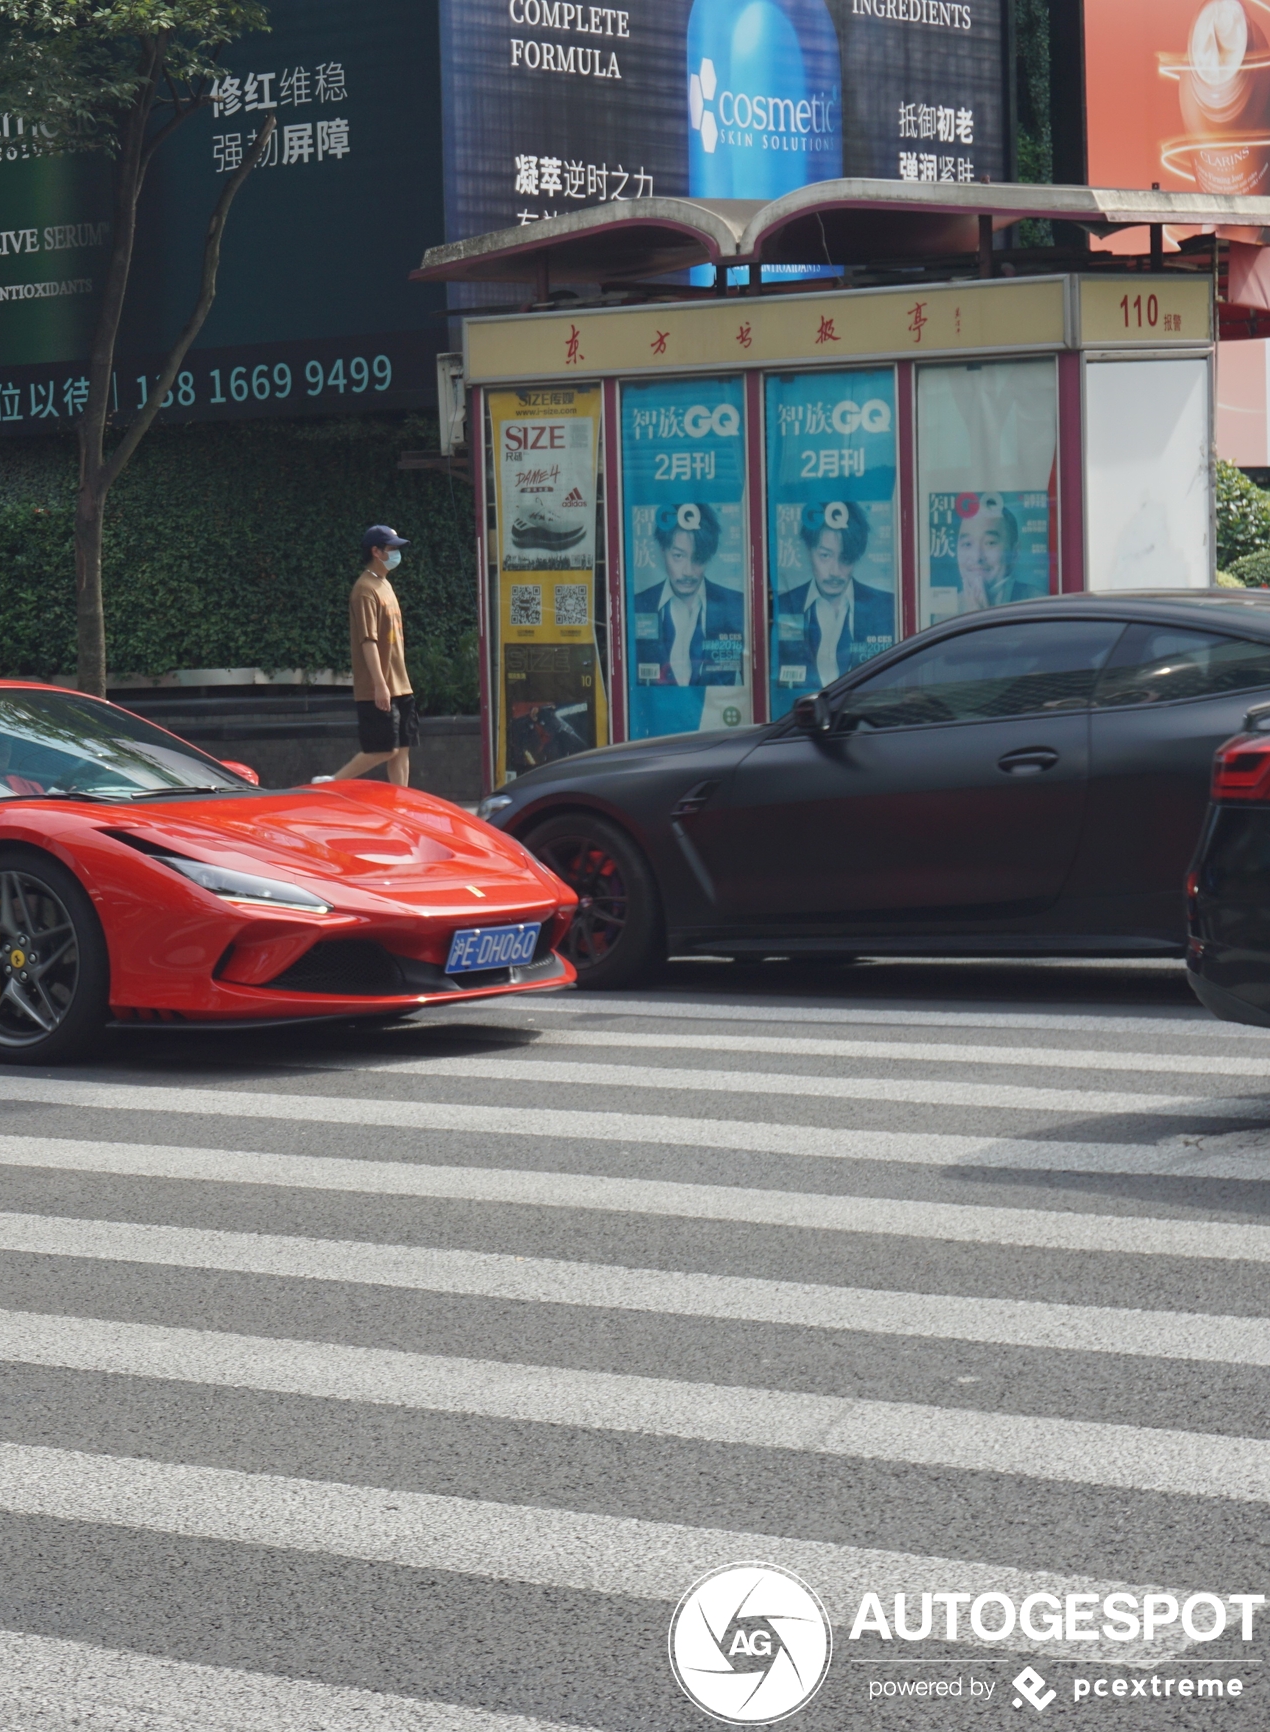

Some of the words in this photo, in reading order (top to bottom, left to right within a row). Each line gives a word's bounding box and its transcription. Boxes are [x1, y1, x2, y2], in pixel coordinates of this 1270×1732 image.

[509, 0, 630, 37] COMPLETE
[510, 38, 622, 79] FORMULA
[210, 61, 348, 118] 修红维稳
[719, 91, 835, 134] cosmetic
[898, 101, 974, 144] 抵御初老
[720, 128, 753, 147] SKIN
[762, 134, 835, 152] SOLUTIONS
[1200, 146, 1249, 168] CLARINS
[515, 153, 654, 200] 凝萃逆时之力
[1120, 293, 1158, 328] 110
[1163, 313, 1181, 332] 报警
[209, 362, 292, 404] 1669
[305, 354, 392, 397] 9499
[632, 403, 740, 441] 智族GQ
[777, 398, 891, 437] 智族GQ
[505, 425, 566, 452] SIZE
[654, 451, 716, 481] 2月刊
[800, 448, 865, 479] 2月刊
[655, 503, 701, 531] GQ
[801, 501, 849, 530] GQ
[930, 494, 956, 558] 智族
[581, 675, 592, 687] 10
